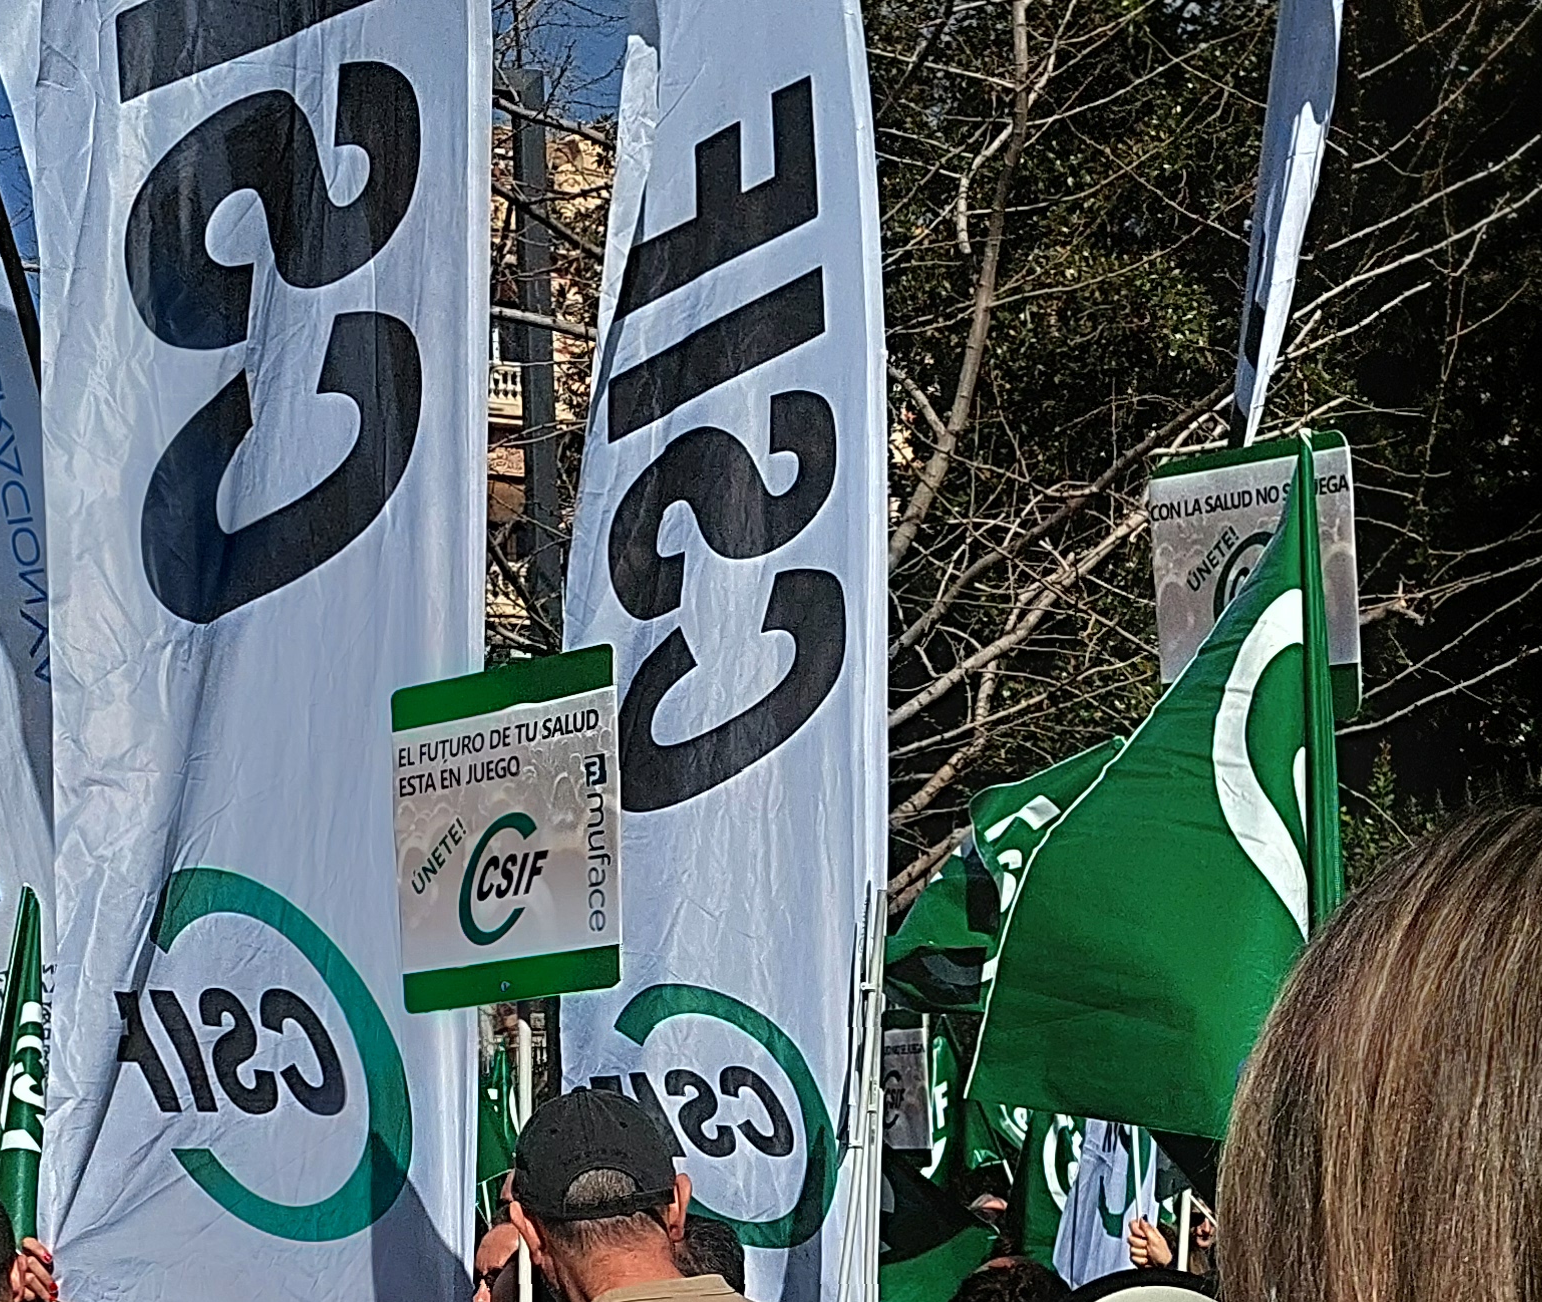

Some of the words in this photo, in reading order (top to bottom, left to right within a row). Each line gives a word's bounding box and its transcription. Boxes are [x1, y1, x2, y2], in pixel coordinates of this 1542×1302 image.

[1150, 502, 1181, 522] CON
[1184, 498, 1203, 517] LA
[1204, 490, 1252, 514] SALUD
[1256, 485, 1280, 506] NO
[1316, 474, 1350, 496] EGA
[1186, 525, 1240, 593] ÚNETE!
[398, 747, 415, 768] EL
[419, 732, 485, 765] FUTURO
[489, 726, 511, 750] DE
[515, 720, 538, 745] TU
[541, 708, 600, 740] SALUD
[466, 755, 520, 785] JUEGO
[411, 816, 467, 895] ÚNETE!
[476, 849, 549, 902] CSIF
[587, 792, 611, 932] muface
